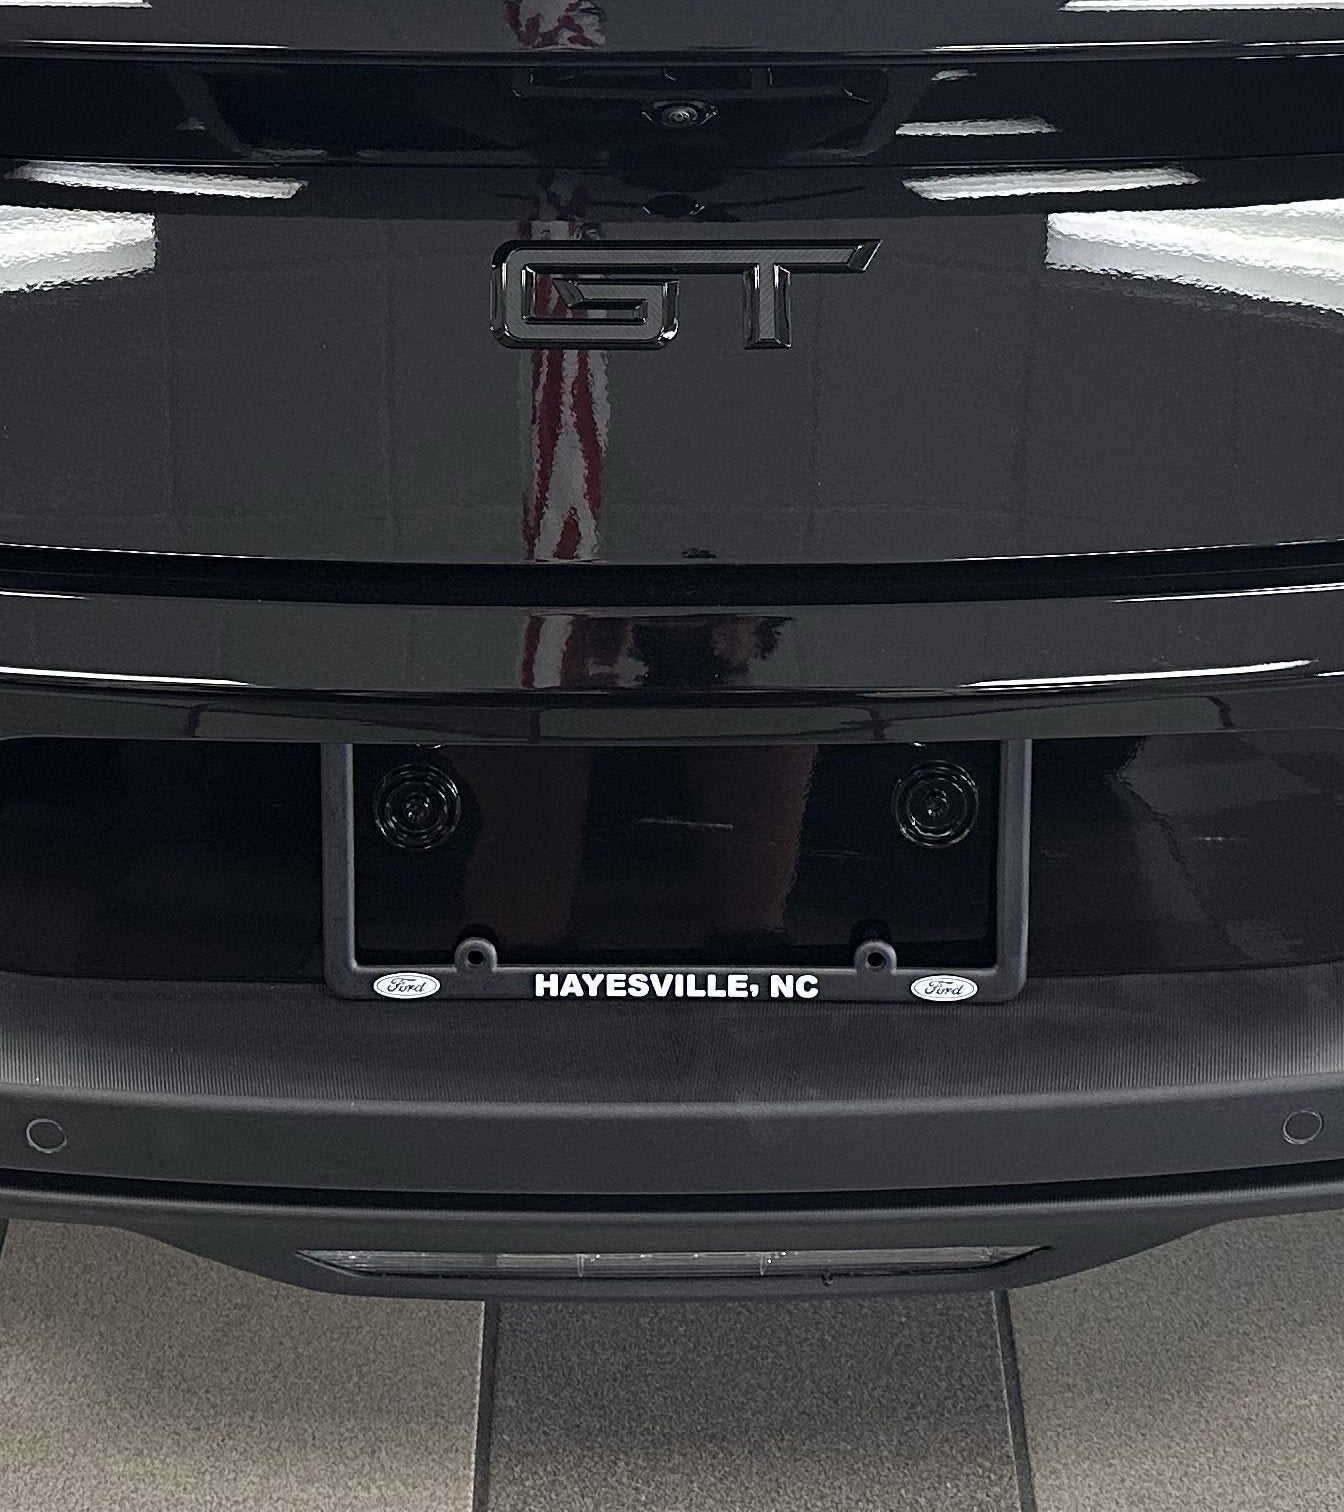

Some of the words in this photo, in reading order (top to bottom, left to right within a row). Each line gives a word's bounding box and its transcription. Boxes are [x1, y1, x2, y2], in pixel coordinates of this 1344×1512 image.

[489, 239, 883, 351] GT
[534, 972, 760, 998] HAYESVILLE,
[769, 974, 819, 999] NC
